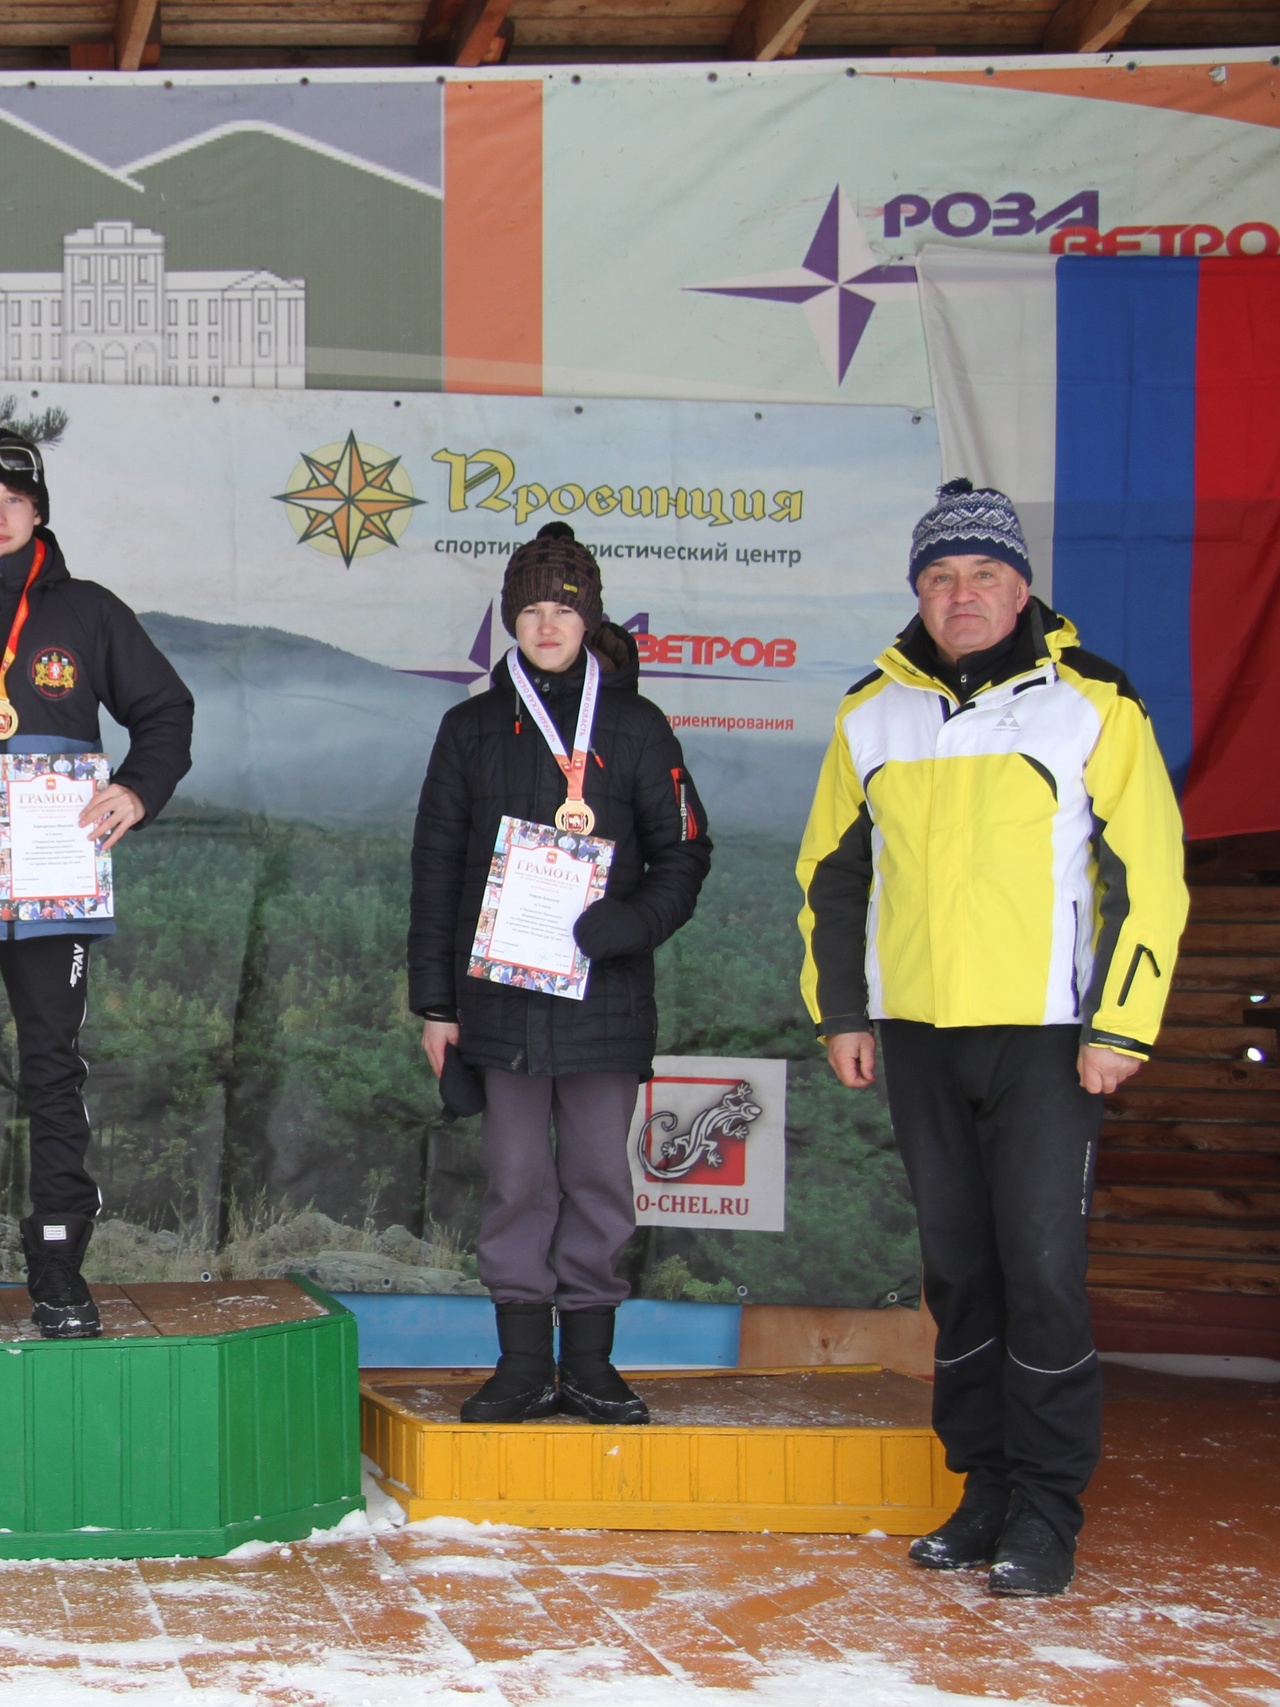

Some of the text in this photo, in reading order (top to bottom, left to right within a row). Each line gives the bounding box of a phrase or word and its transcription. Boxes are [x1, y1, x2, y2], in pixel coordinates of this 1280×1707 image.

[883, 190, 1100, 238] РОЗА
[431, 448, 803, 528] Провинция
[734, 543, 802, 568] центр
[633, 634, 797, 668] ВЕТРОВ
[19, 792, 84, 804] ГРАМОТА
[516, 860, 581, 883] ГРАМОТА
[636, 1193, 750, 1216] O-CHEL.RU
